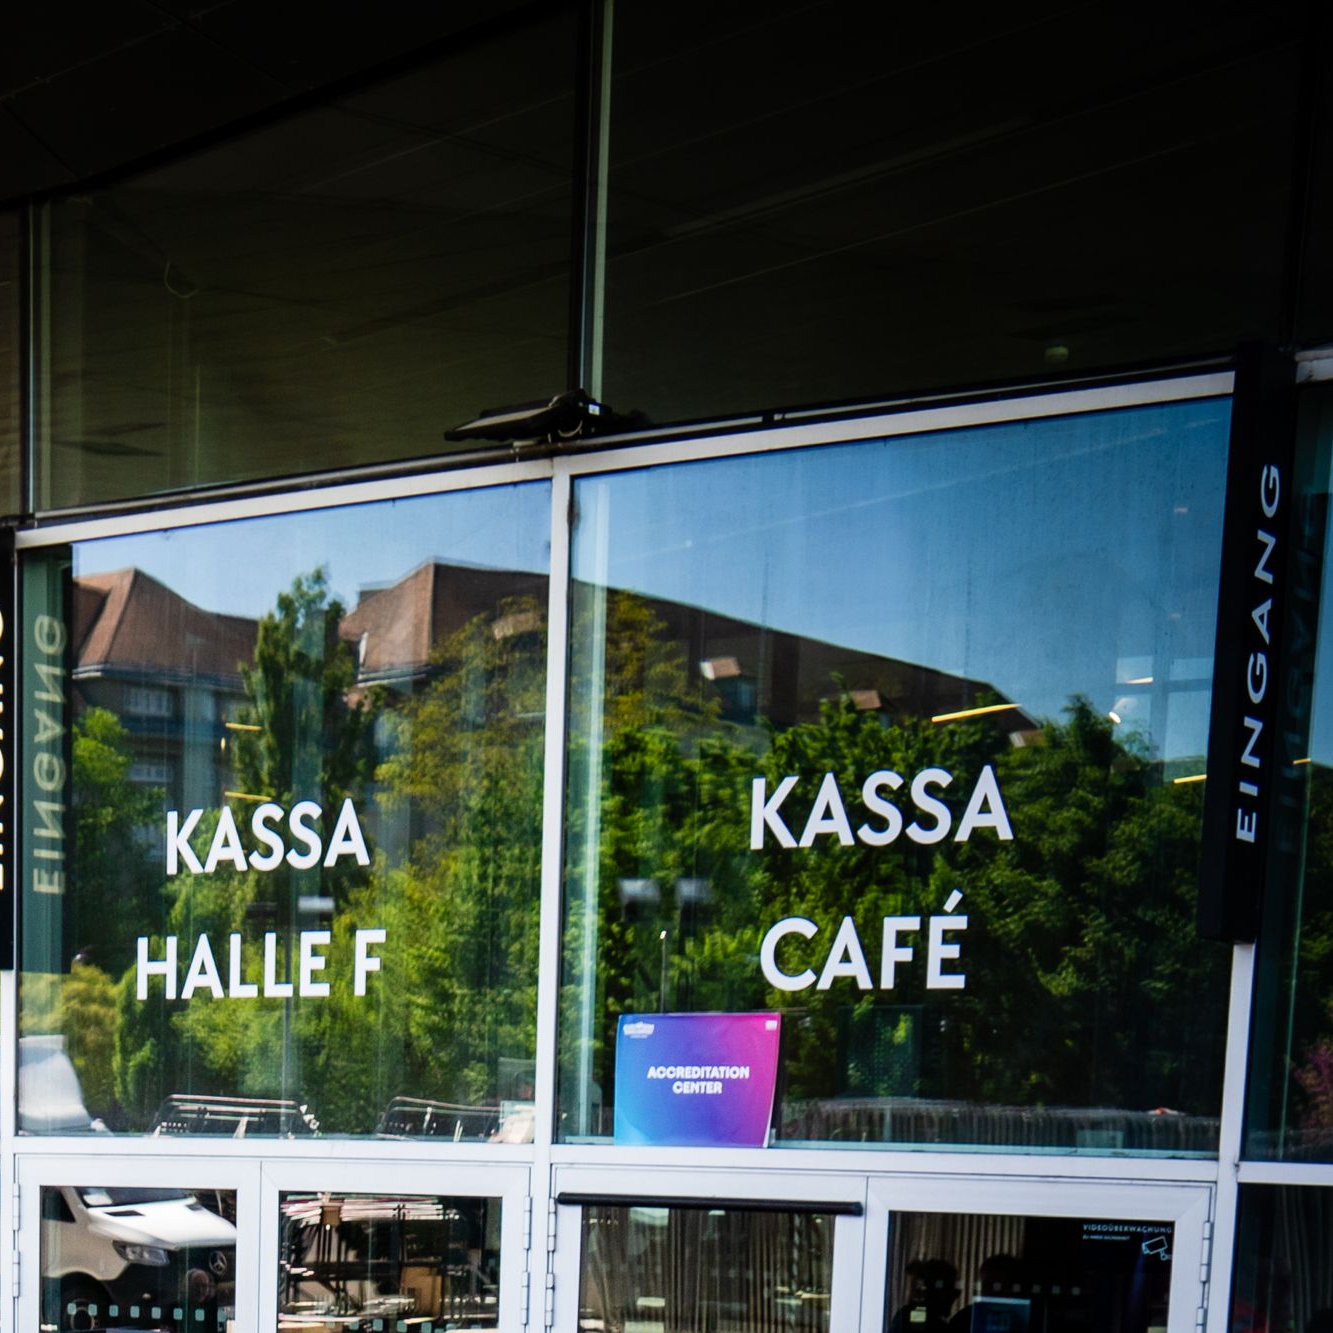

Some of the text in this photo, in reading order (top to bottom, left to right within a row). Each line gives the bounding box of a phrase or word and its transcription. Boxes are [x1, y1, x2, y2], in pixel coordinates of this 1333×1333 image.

[1236, 463, 1280, 844] EINGANG
[166, 798, 370, 875] KASSA
[750, 765, 1013, 850] KASSA
[136, 929, 387, 1000] HALLE F
[760, 889, 968, 991] CAFÉ
[647, 1065, 750, 1079] ACCREDITATION
[672, 1081, 723, 1094] CENTER
